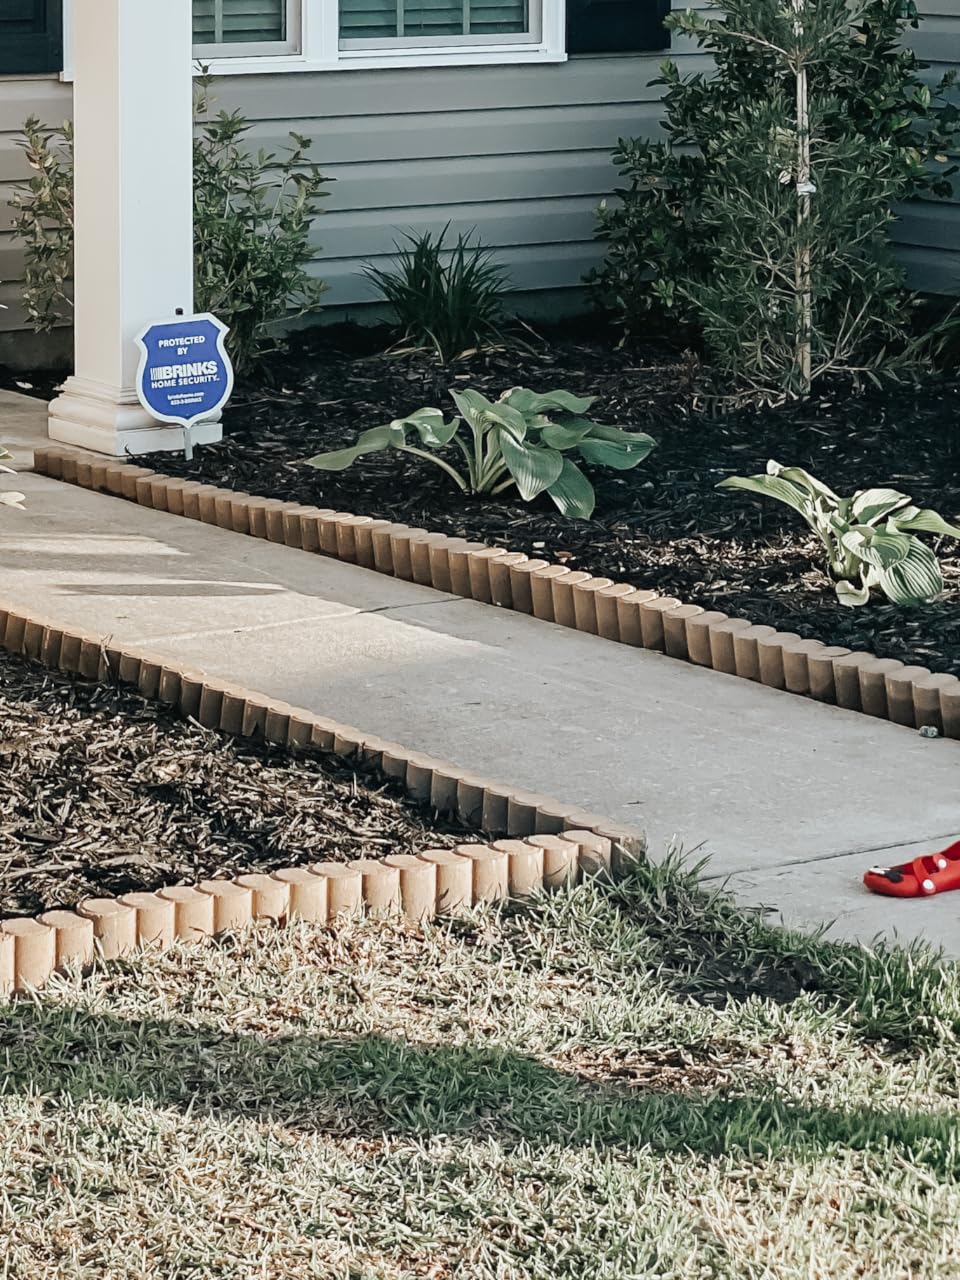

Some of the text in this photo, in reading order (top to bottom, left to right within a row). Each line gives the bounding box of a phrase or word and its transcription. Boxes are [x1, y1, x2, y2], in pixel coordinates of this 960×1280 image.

[158, 335, 206, 348] PROTECTED
[177, 347, 189, 356] BY
[162, 360, 218, 379] BRINKS
[151, 380, 177, 389] HOME
